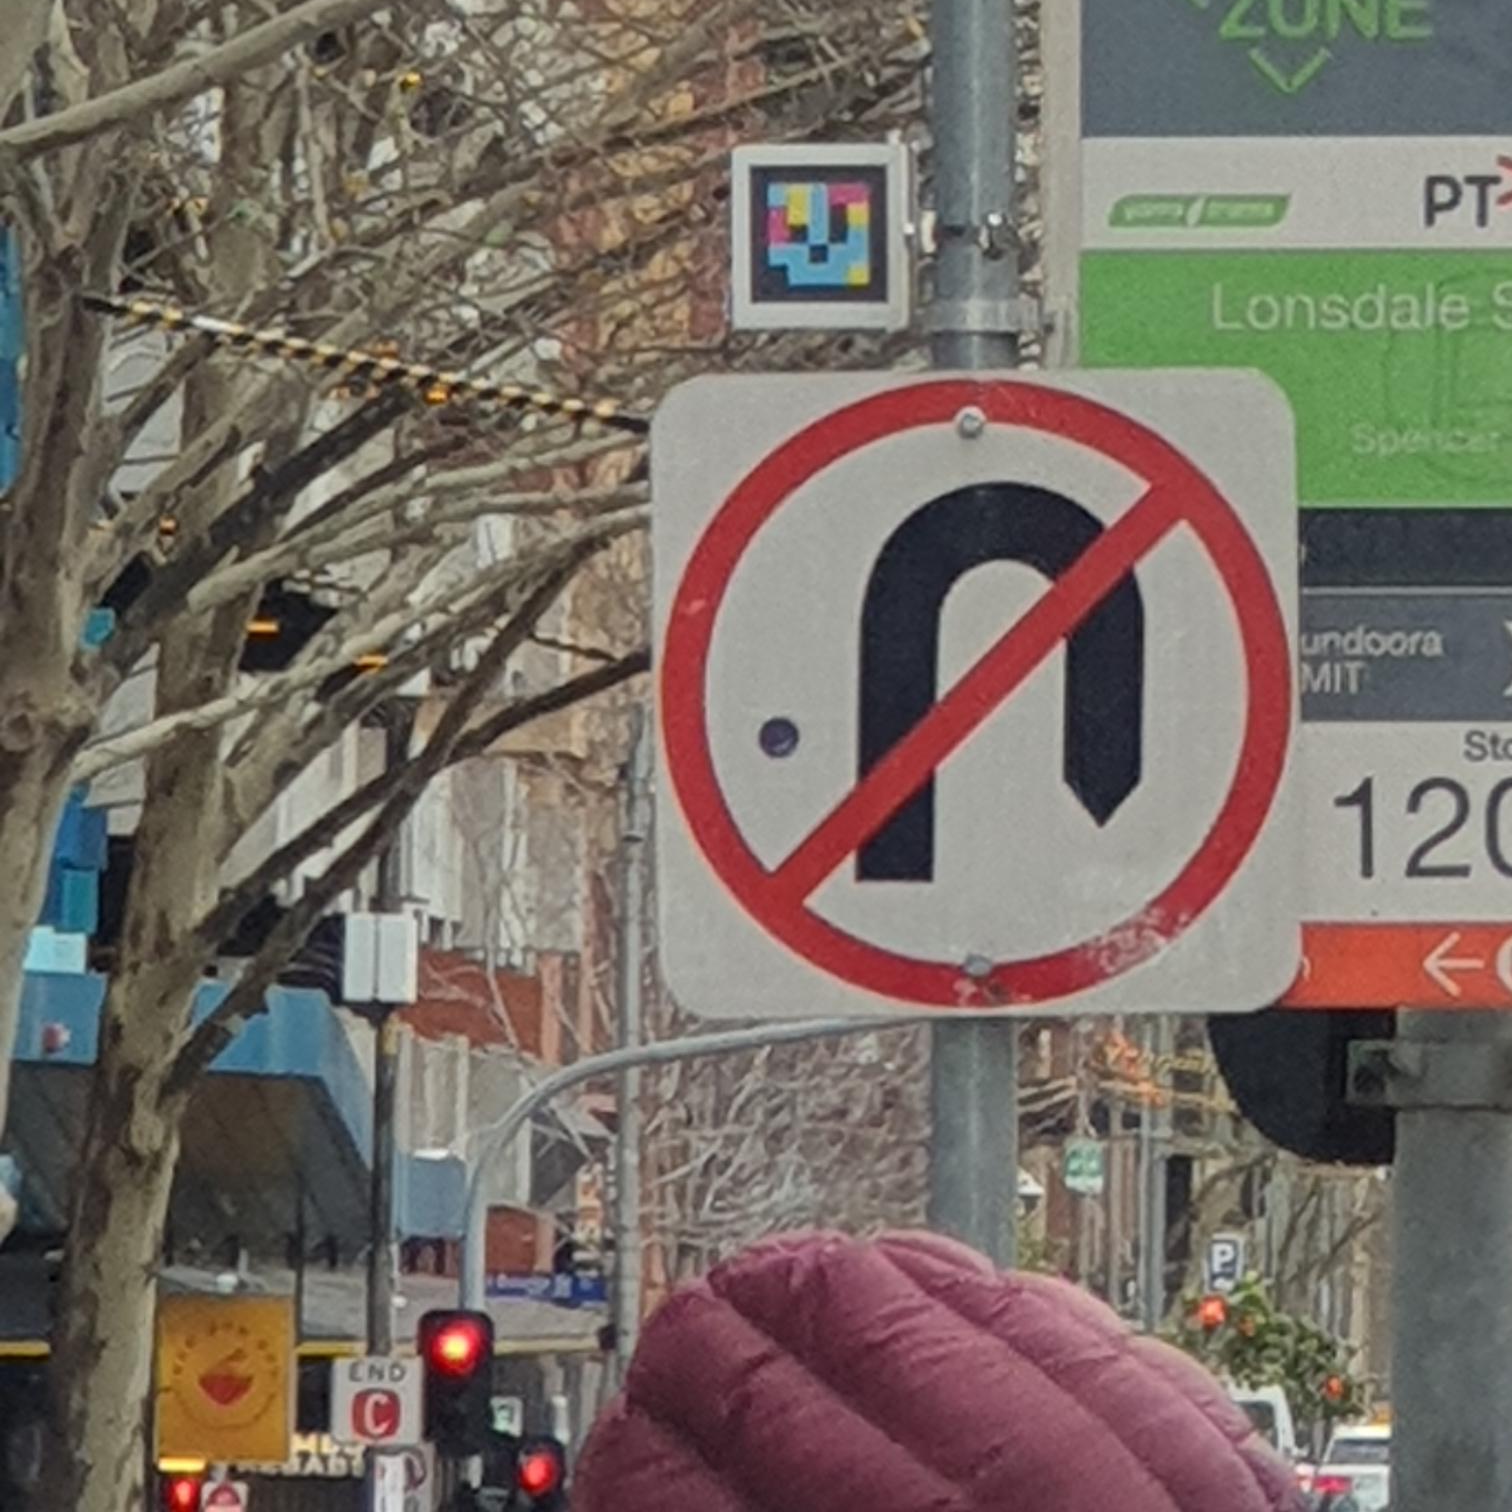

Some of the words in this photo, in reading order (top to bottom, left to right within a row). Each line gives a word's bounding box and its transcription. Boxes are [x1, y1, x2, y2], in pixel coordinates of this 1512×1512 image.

[1211, 282, 1470, 331] Lonsdale
[1301, 623, 1444, 657] undoora
[1301, 660, 1366, 695] MIT
[348, 1361, 407, 1382] END
[363, 1392, 391, 1435] C
